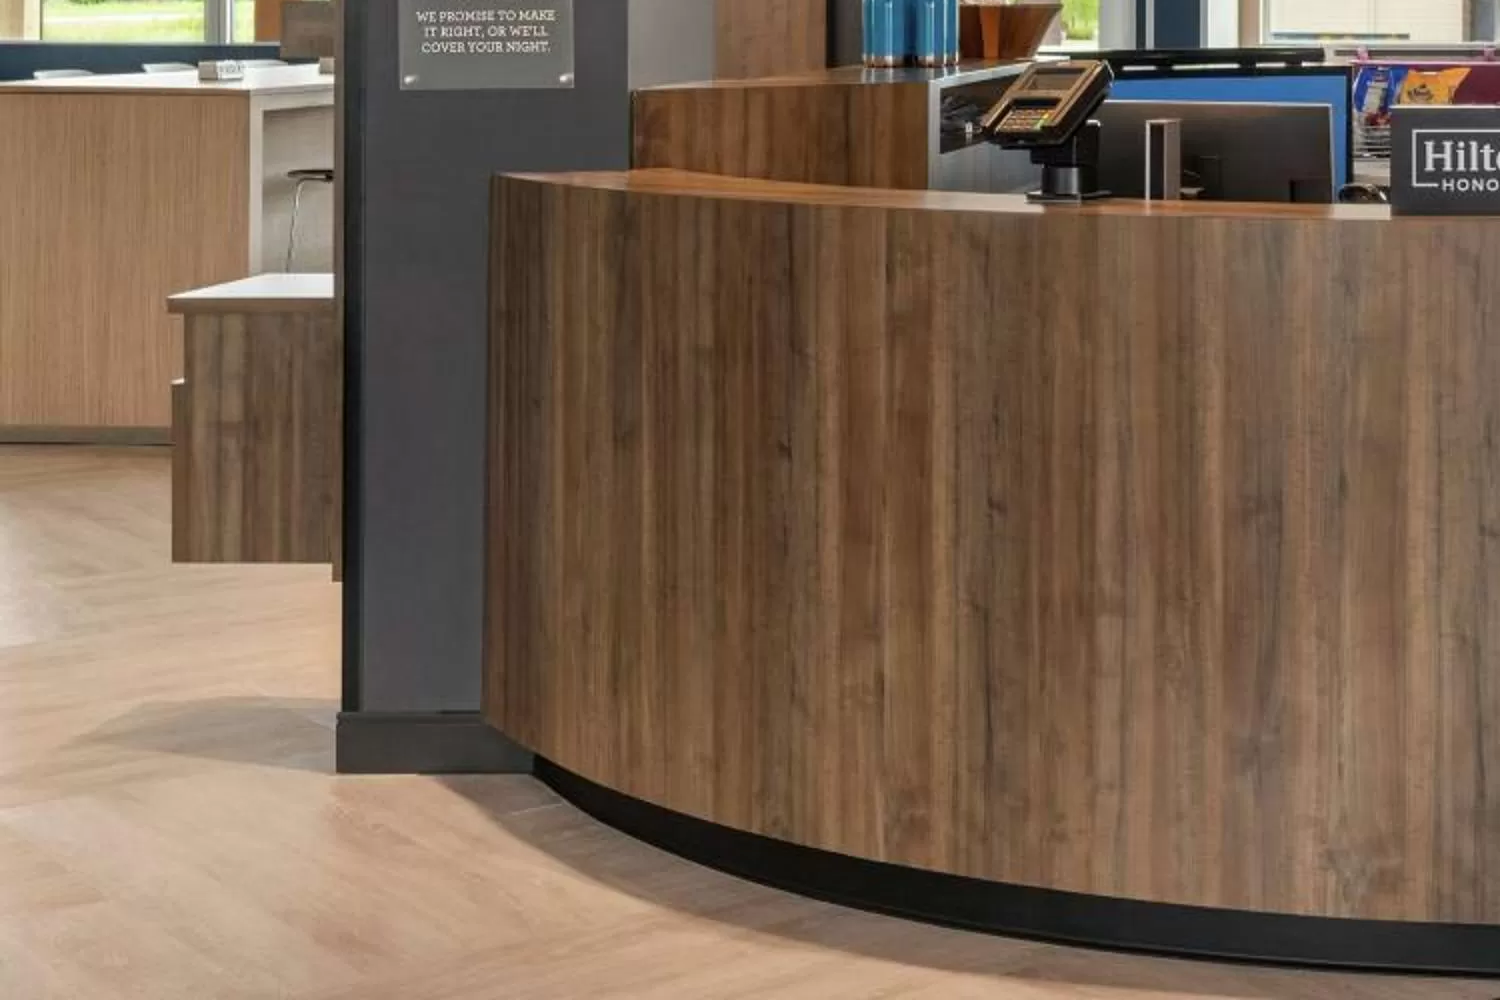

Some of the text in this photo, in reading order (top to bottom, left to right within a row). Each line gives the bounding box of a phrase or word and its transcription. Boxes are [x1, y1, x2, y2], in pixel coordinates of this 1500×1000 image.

[416, 10, 556, 23] WE PROMISE TO MAKE
[424, 25, 548, 38] IT RIGHT, OR WE'LL
[421, 41, 551, 53] COVER YOUR NIGHT.
